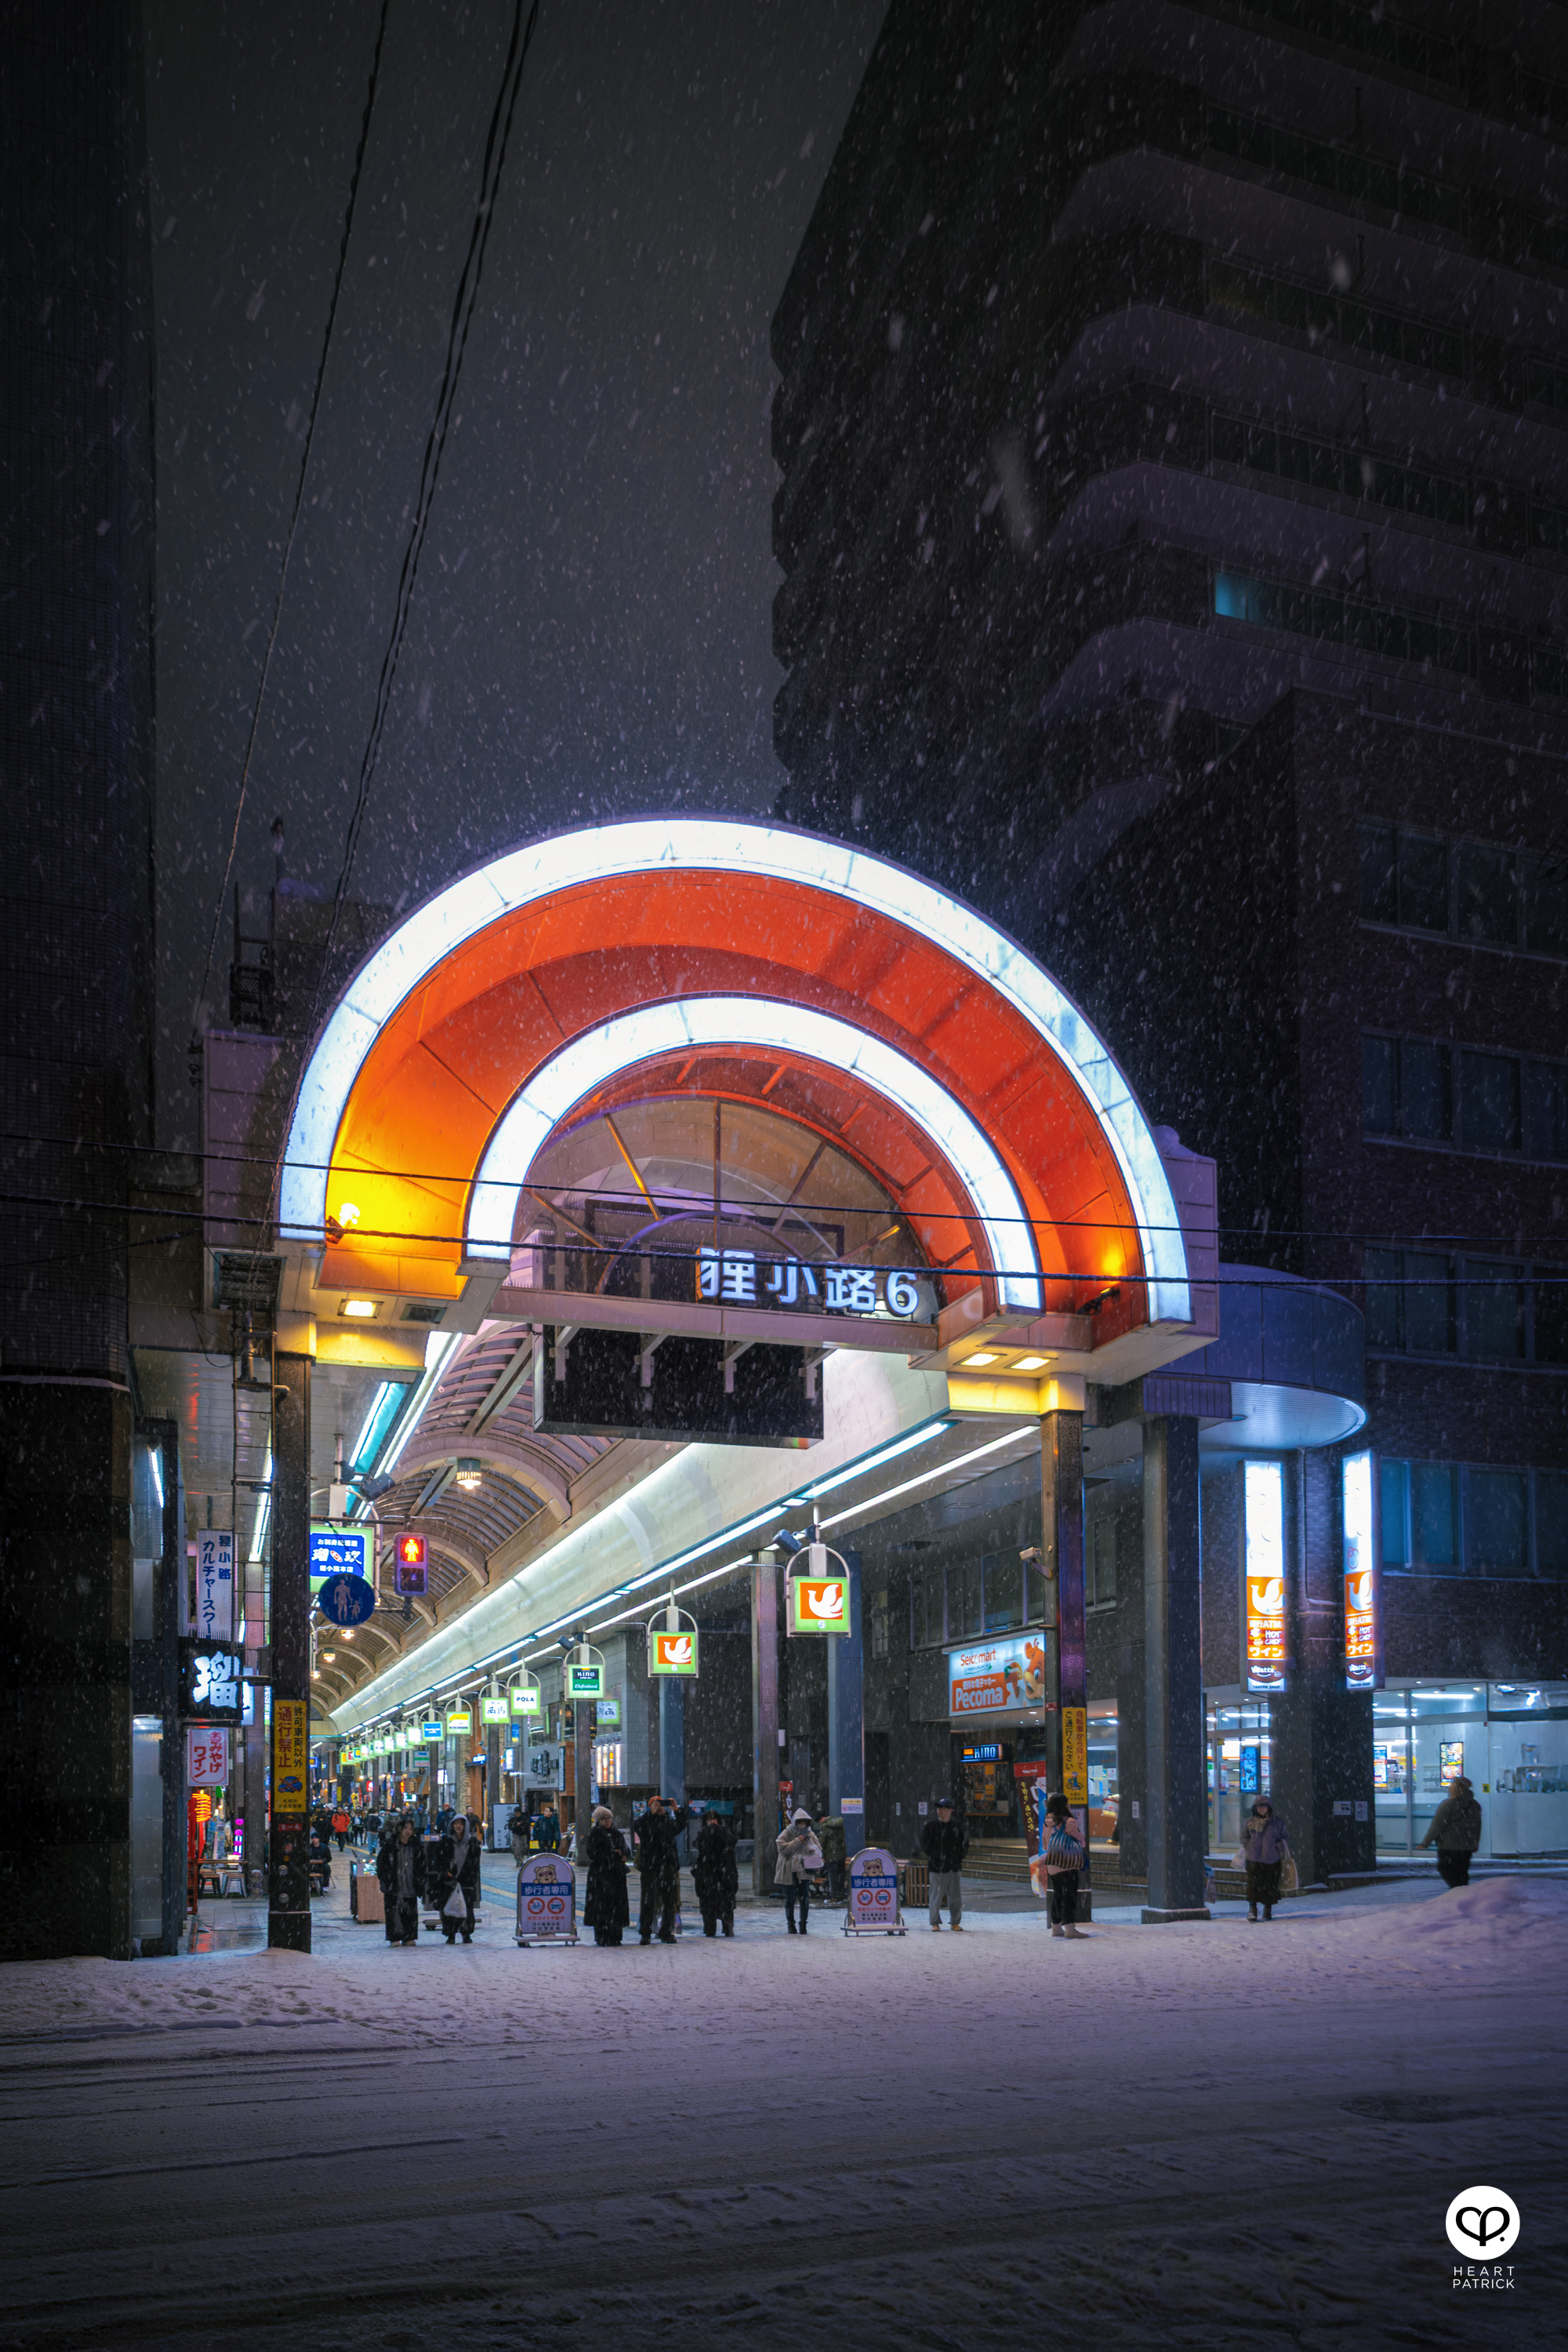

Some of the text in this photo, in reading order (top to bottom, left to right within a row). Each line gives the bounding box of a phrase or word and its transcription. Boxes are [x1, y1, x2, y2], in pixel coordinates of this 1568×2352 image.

[699, 1247, 919, 1316] 狸小路6
[202, 1541, 216, 1639] カルチャースクー
[818, 1620, 826, 1628] 6
[1265, 1630, 1283, 1639] HOT
[1359, 1626, 1373, 1635] HOT
[1249, 1647, 1283, 1657] ワイン
[1347, 1643, 1372, 1655] ワイン
[956, 1686, 1003, 1709] Pecoma
[277, 1706, 292, 1768] 通行禁止
[293, 1706, 303, 1768] 許可車両以外
[1065, 1711, 1074, 1770] ご通行ください
[193, 1746, 207, 1778] ワイン
[209, 1731, 223, 1773] おみやげ
[524, 1886, 568, 1895] 歩行者専用
[854, 1878, 894, 1887] 歩行者専用
